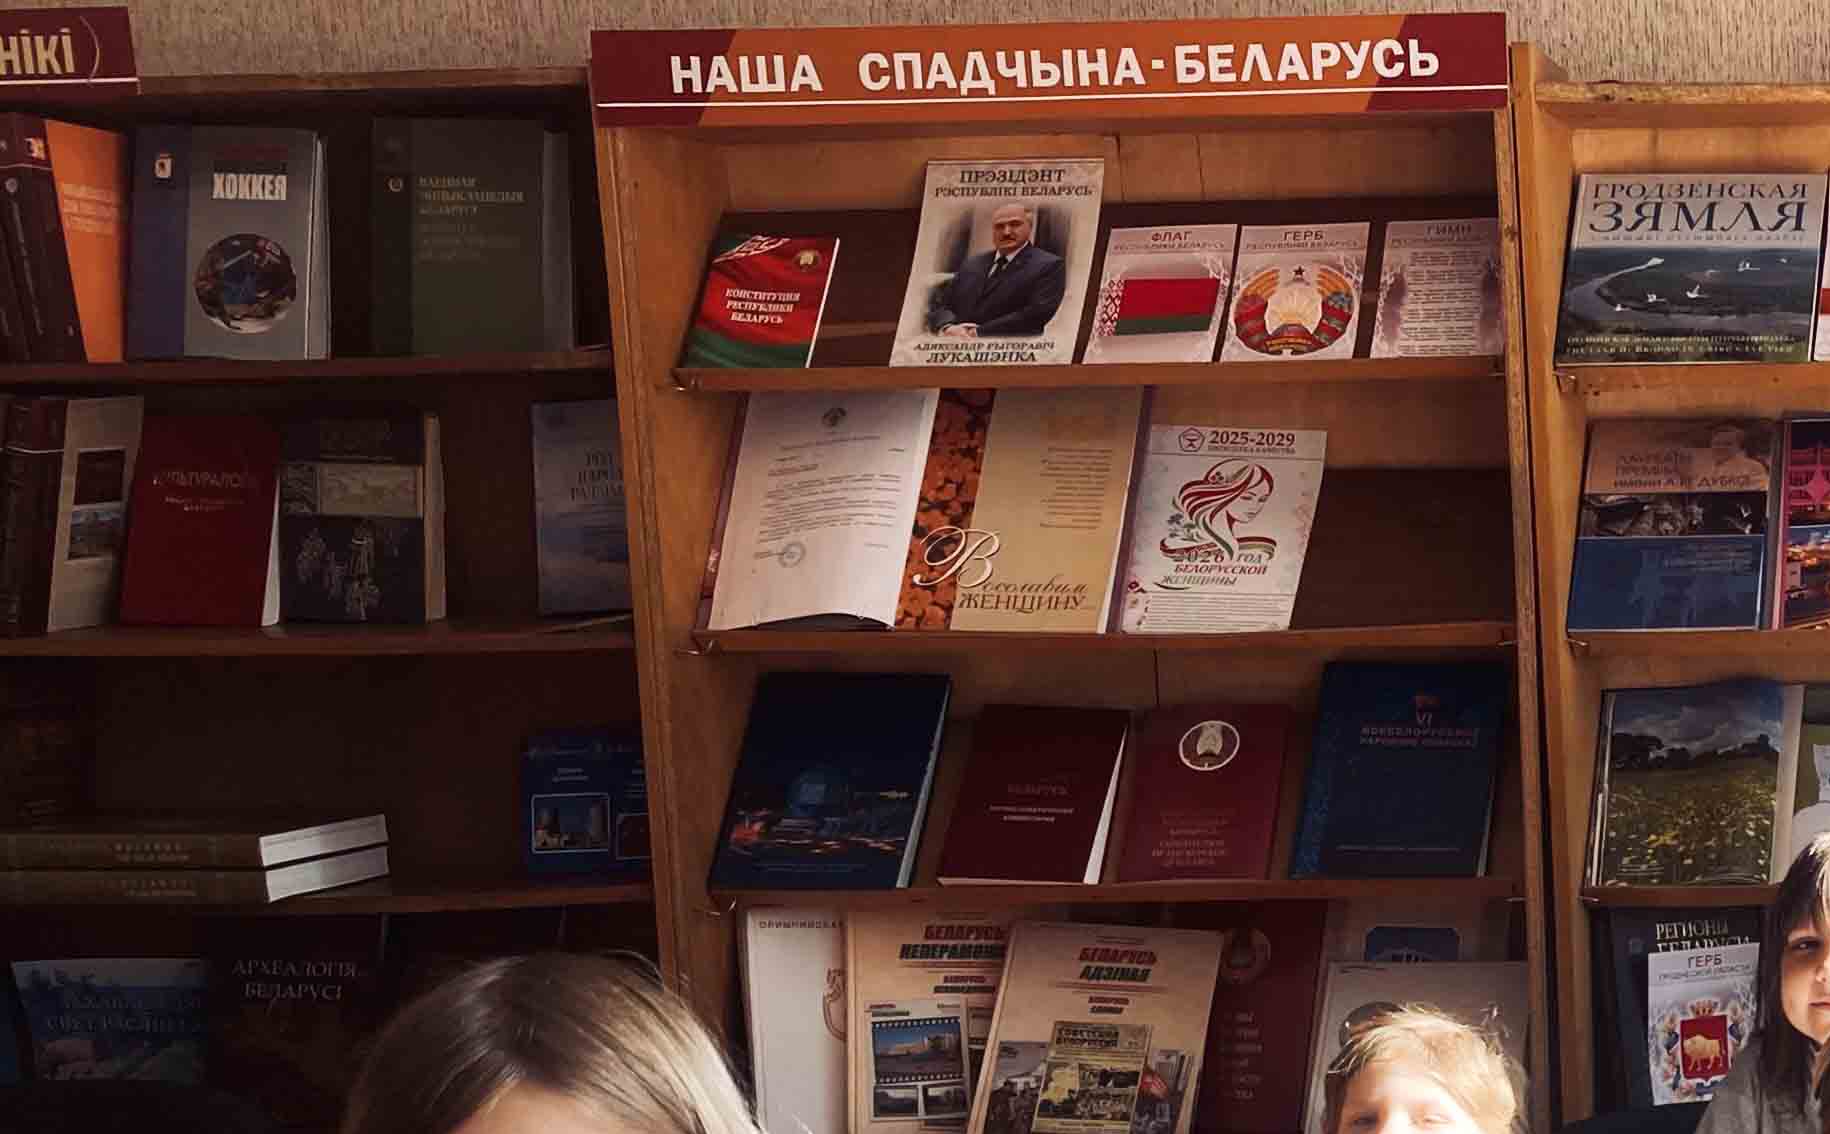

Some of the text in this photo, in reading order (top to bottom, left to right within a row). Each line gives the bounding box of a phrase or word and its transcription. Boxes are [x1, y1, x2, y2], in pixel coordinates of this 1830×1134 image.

[670, 53, 824, 95] НАША
[959, 168, 1067, 185] ПРЭЗІДЭНТ
[211, 172, 288, 201] ХОККЕЯ
[1592, 183, 1809, 200] ГРОДЗЕНСКАЯ
[1588, 200, 1806, 233] ЗЯМЛЯ
[1283, 230, 1325, 241] ГЕРБ
[926, 351, 1038, 364] ЛУКАШЭНКА
[1208, 430, 1296, 447] 2025-2029
[957, 592, 1086, 615] ЖЕНЩИНУ
[1078, 948, 1158, 965] БЕЛАРУСЬ
[1688, 954, 1723, 969] ГЕРБ
